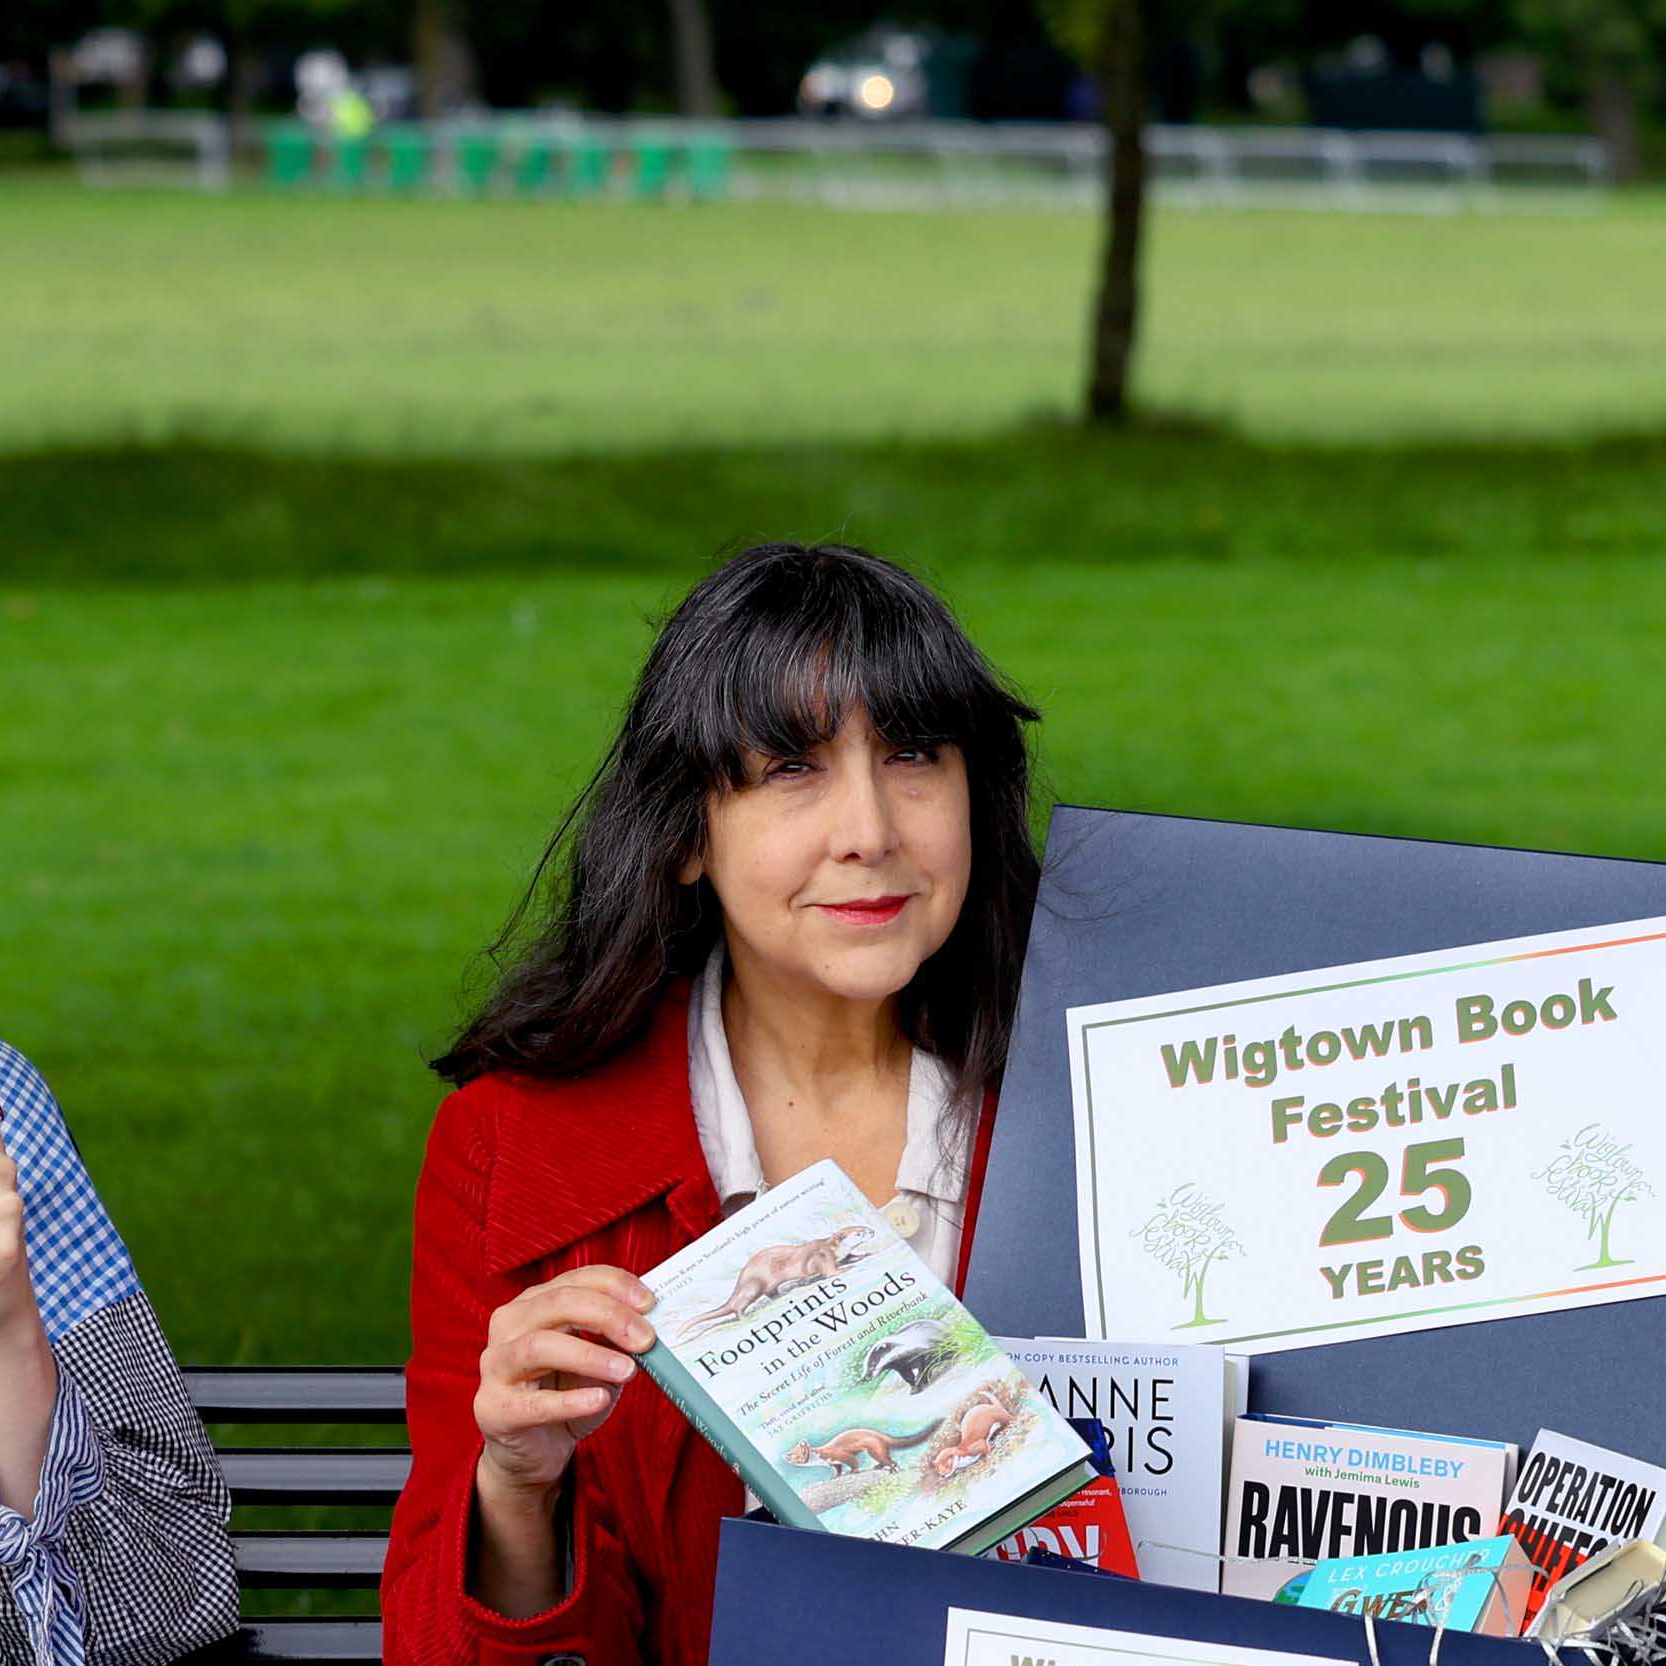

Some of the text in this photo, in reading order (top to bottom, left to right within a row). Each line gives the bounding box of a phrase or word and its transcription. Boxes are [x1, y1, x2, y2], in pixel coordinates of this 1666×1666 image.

[1159, 977, 1618, 1089] Wigtown Book
[1271, 1063, 1517, 1143] Festival
[1316, 1136, 1472, 1247] 25
[1320, 1245, 1485, 1300] YEARS
[695, 1276, 848, 1378] Footprints
[738, 1398, 759, 1415] The
[758, 1378, 790, 1403] Secret
[790, 1364, 813, 1383] Life
[824, 1337, 857, 1362] Forest
[855, 1324, 878, 1343] and
[877, 1292, 930, 1330] Riverbank
[760, 1271, 917, 1377] in the Woods
[1024, 1352, 1054, 1363] COPY
[1058, 1354, 1130, 1365] BESTSELLING
[1133, 1356, 1179, 1367] AUTHOR
[1039, 1373, 1174, 1422] ANNE
[1119, 1487, 1167, 1497] BOROUGH
[1265, 1439, 1465, 1479] HENRY DIMBLEBY
[1304, 1466, 1421, 1489] with Jemima Lewis
[895, 1498, 967, 1546] ER-KAYE
[1237, 1480, 1481, 1559] RAVENOUS
[1517, 1452, 1656, 1539] OPERATION
[1328, 1565, 1366, 1584] LEX
[1503, 1508, 1609, 1591] CHIFF
[1330, 1587, 1429, 1620] GWE
